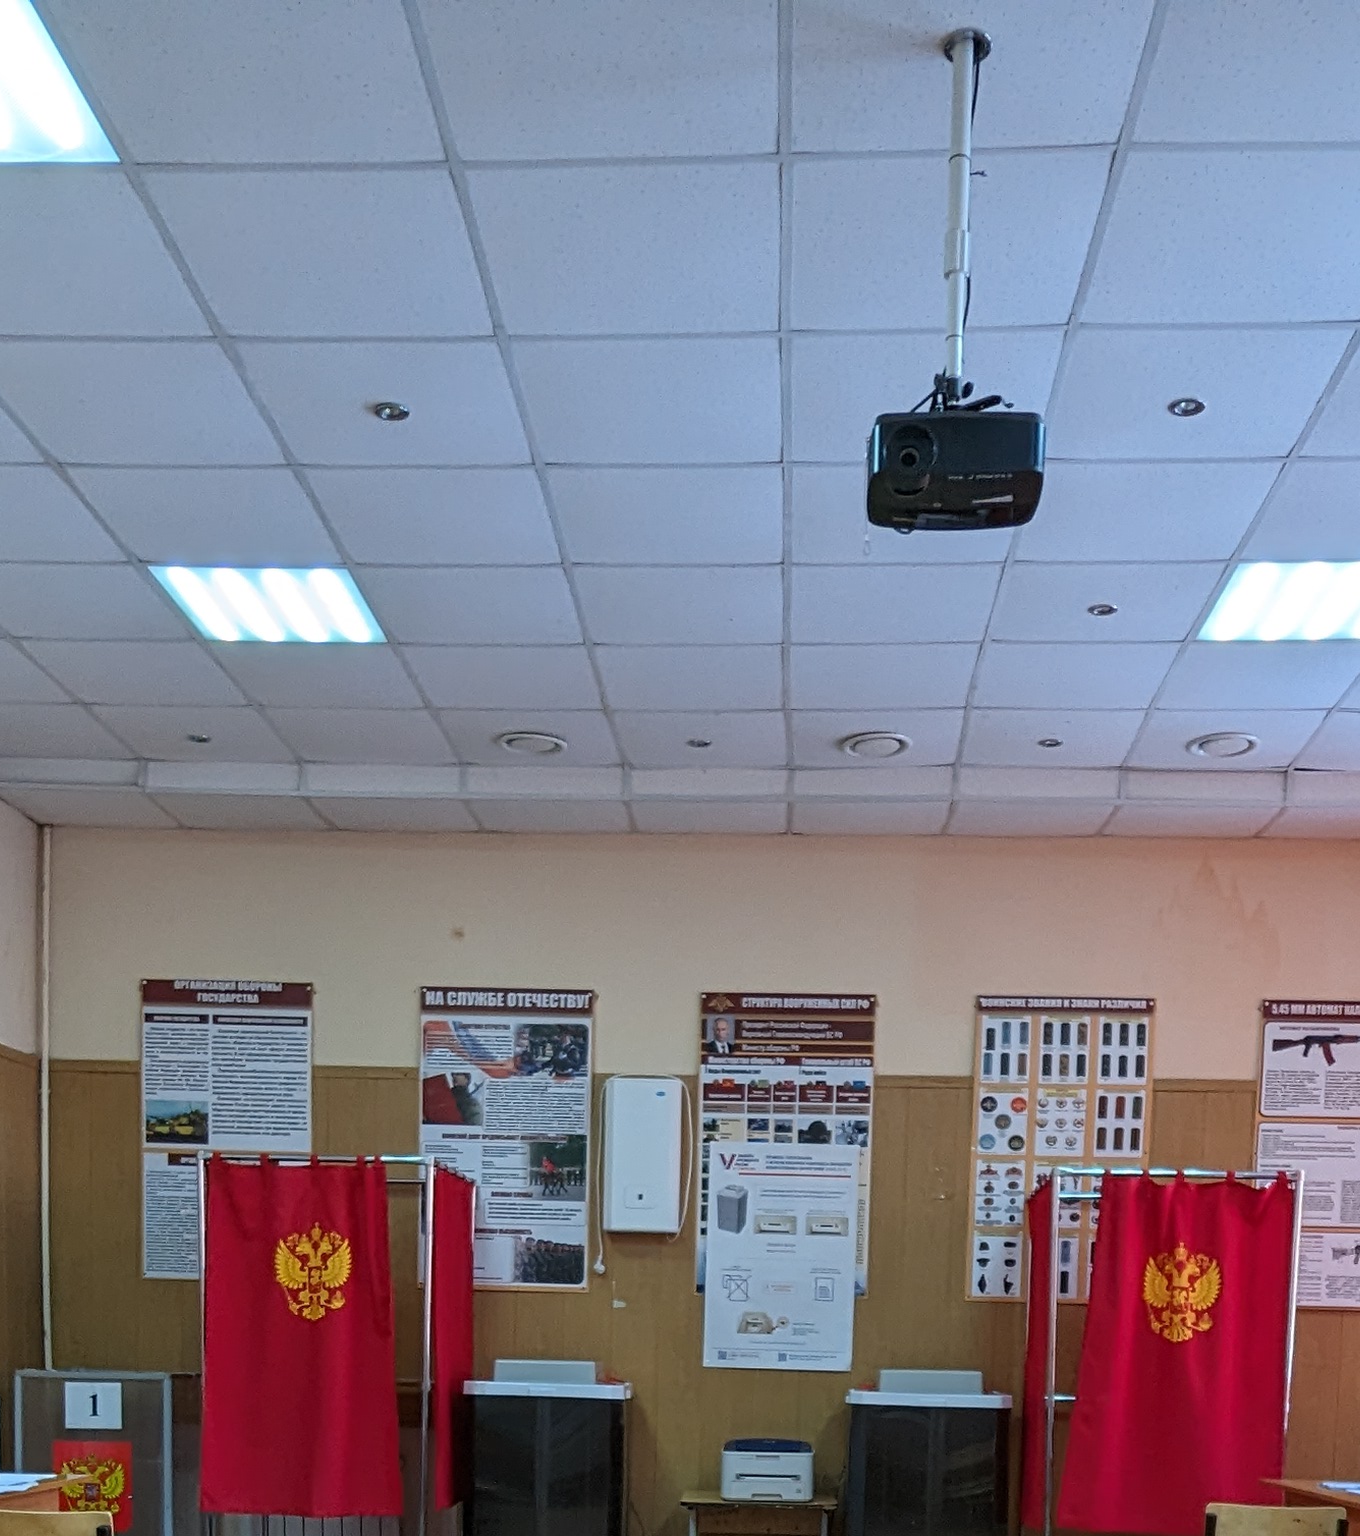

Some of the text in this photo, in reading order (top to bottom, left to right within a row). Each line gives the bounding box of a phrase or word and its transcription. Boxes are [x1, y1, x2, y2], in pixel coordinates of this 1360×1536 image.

[197, 992, 260, 1004] ГОСУДАРСТВА
[425, 991, 590, 1009] НА СЛУЖБЕ ОТЕЧЕСТВУ!
[857, 998, 870, 1010] РФ
[1305, 1004, 1343, 1016] АВТОМАТ
[89, 1393, 100, 1417] 1
